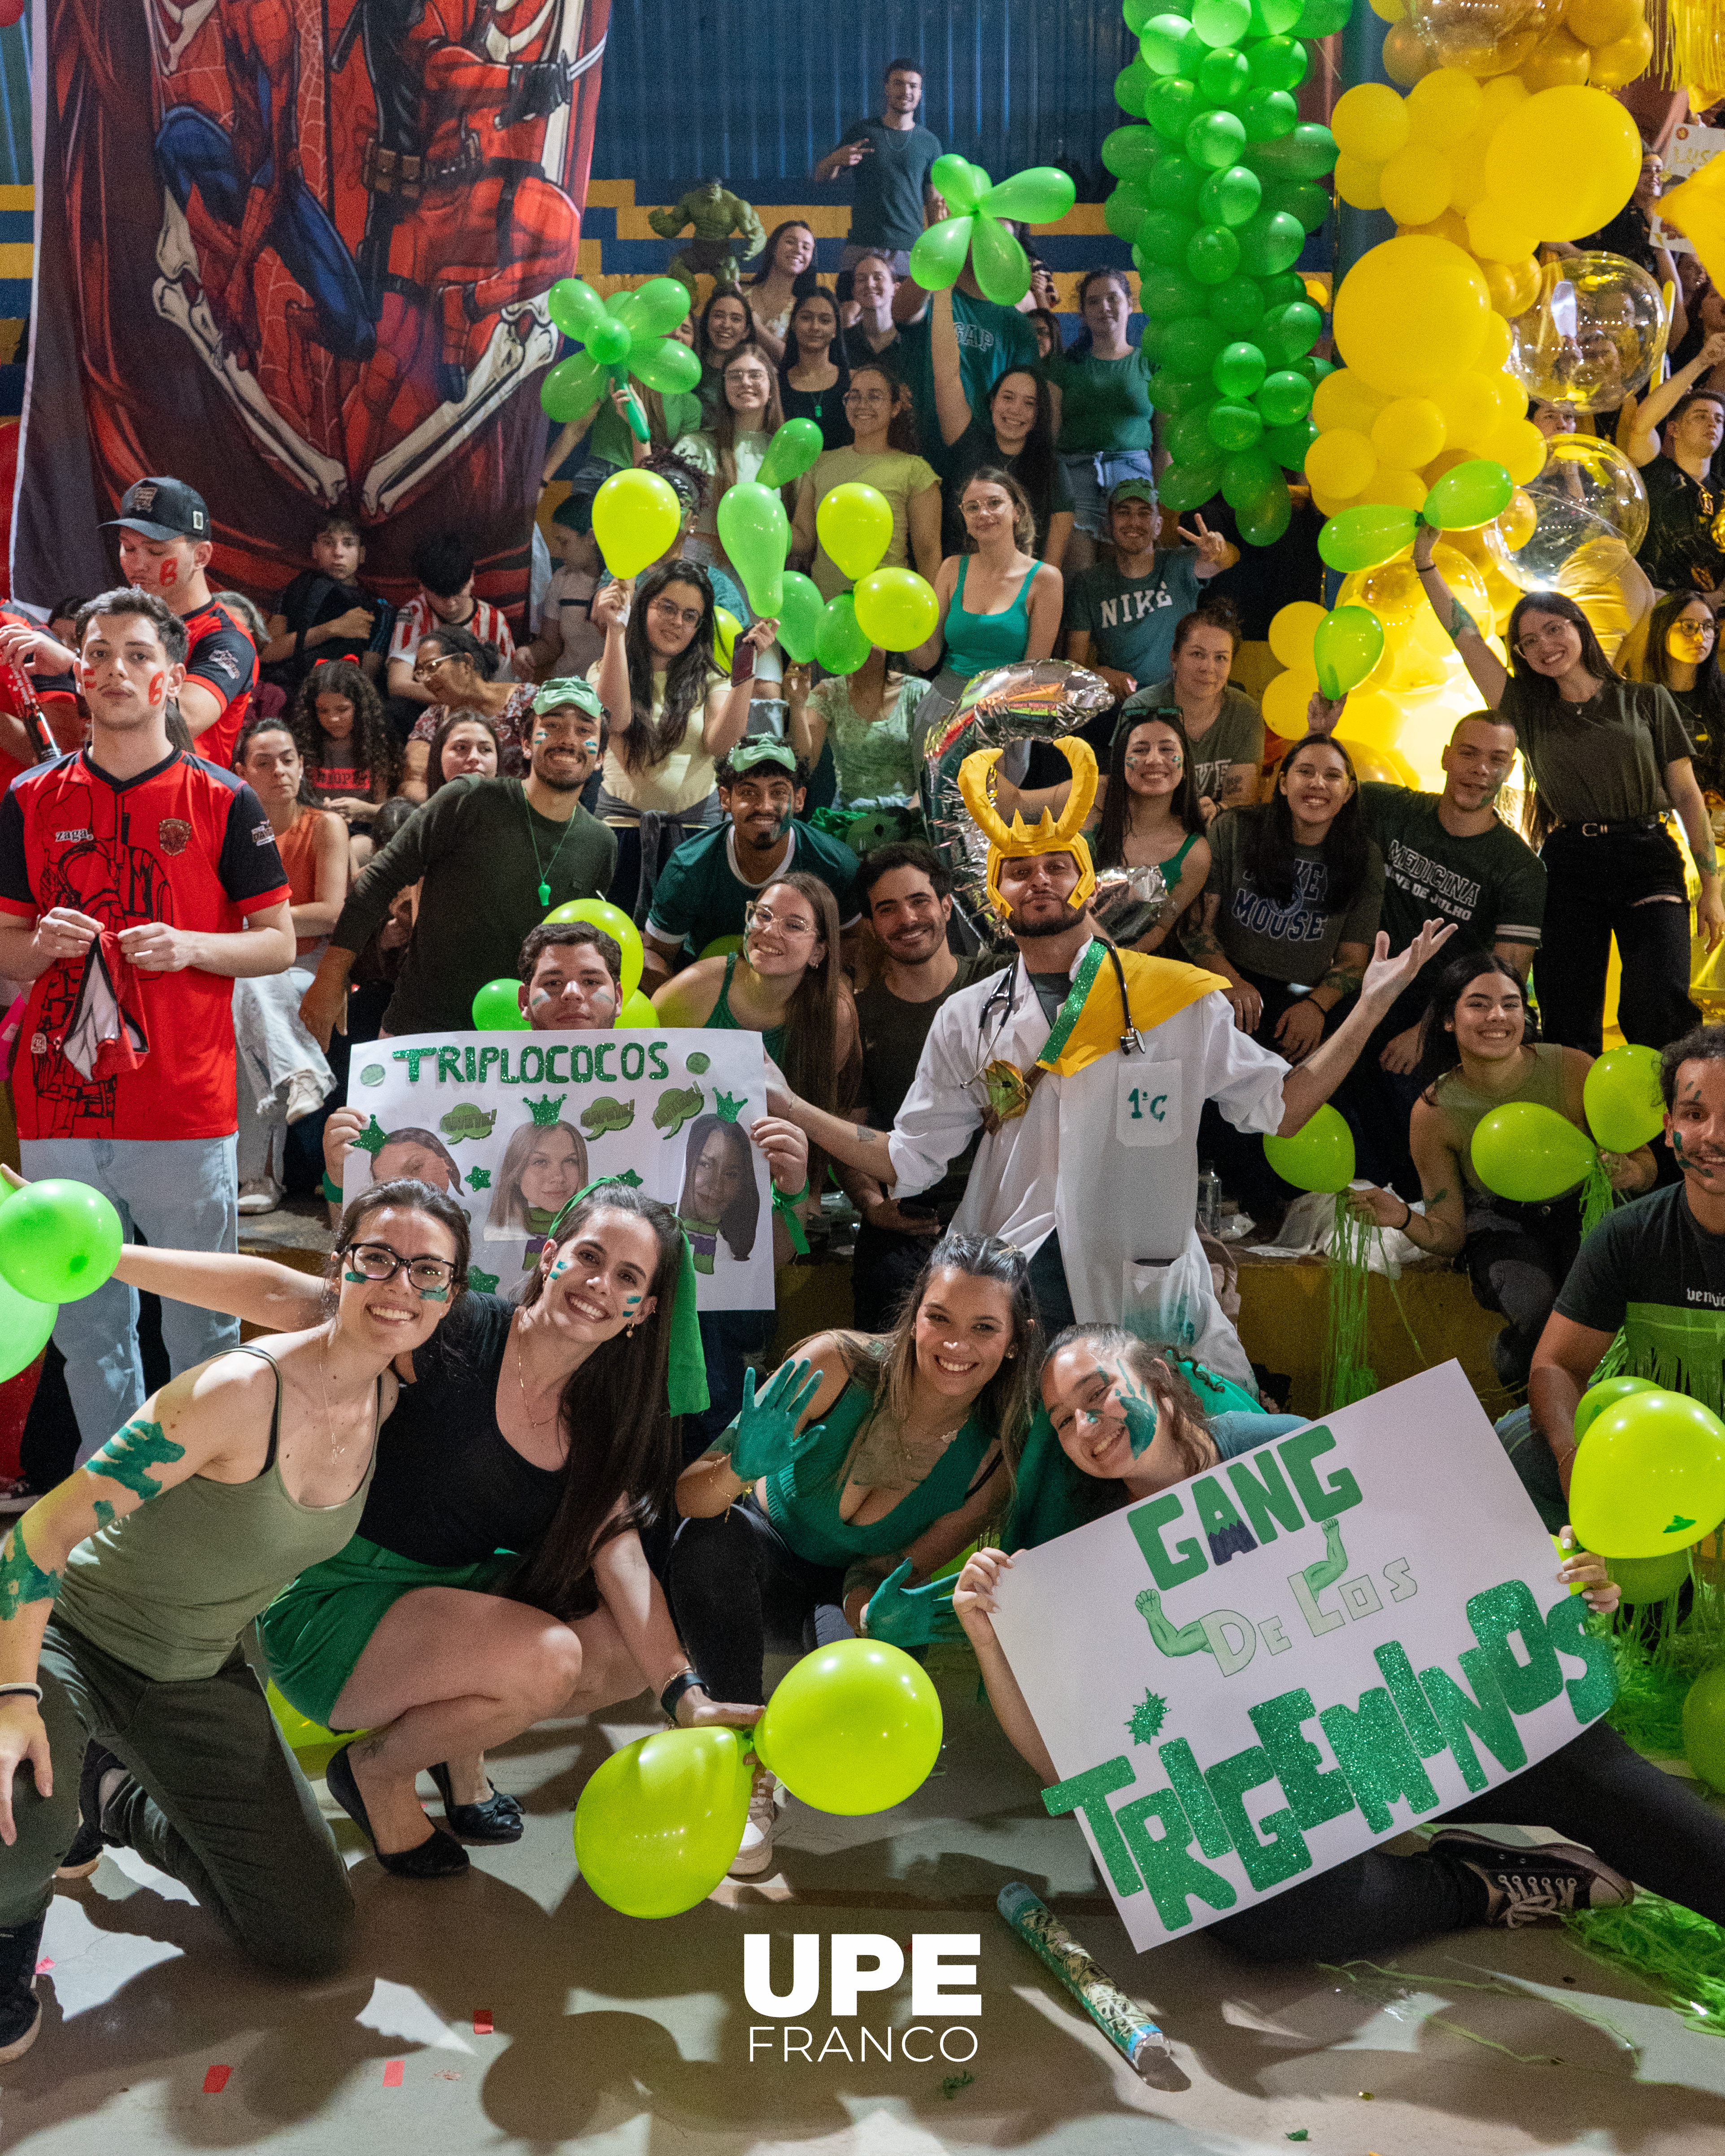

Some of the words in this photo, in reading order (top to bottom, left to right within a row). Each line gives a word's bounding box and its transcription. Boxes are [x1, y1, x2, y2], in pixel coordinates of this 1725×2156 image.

[953, 322, 994, 352] GAP
[1389, 839, 1481, 907] MEDICINA
[1411, 883, 1430, 899] DE
[1232, 887, 1329, 942] MOUSE
[392, 1041, 669, 1084] TRIPLOCOCOS
[1127, 1424, 1363, 1591] GANG
[1041, 1579, 1619, 1932] TRIGEMINOS
